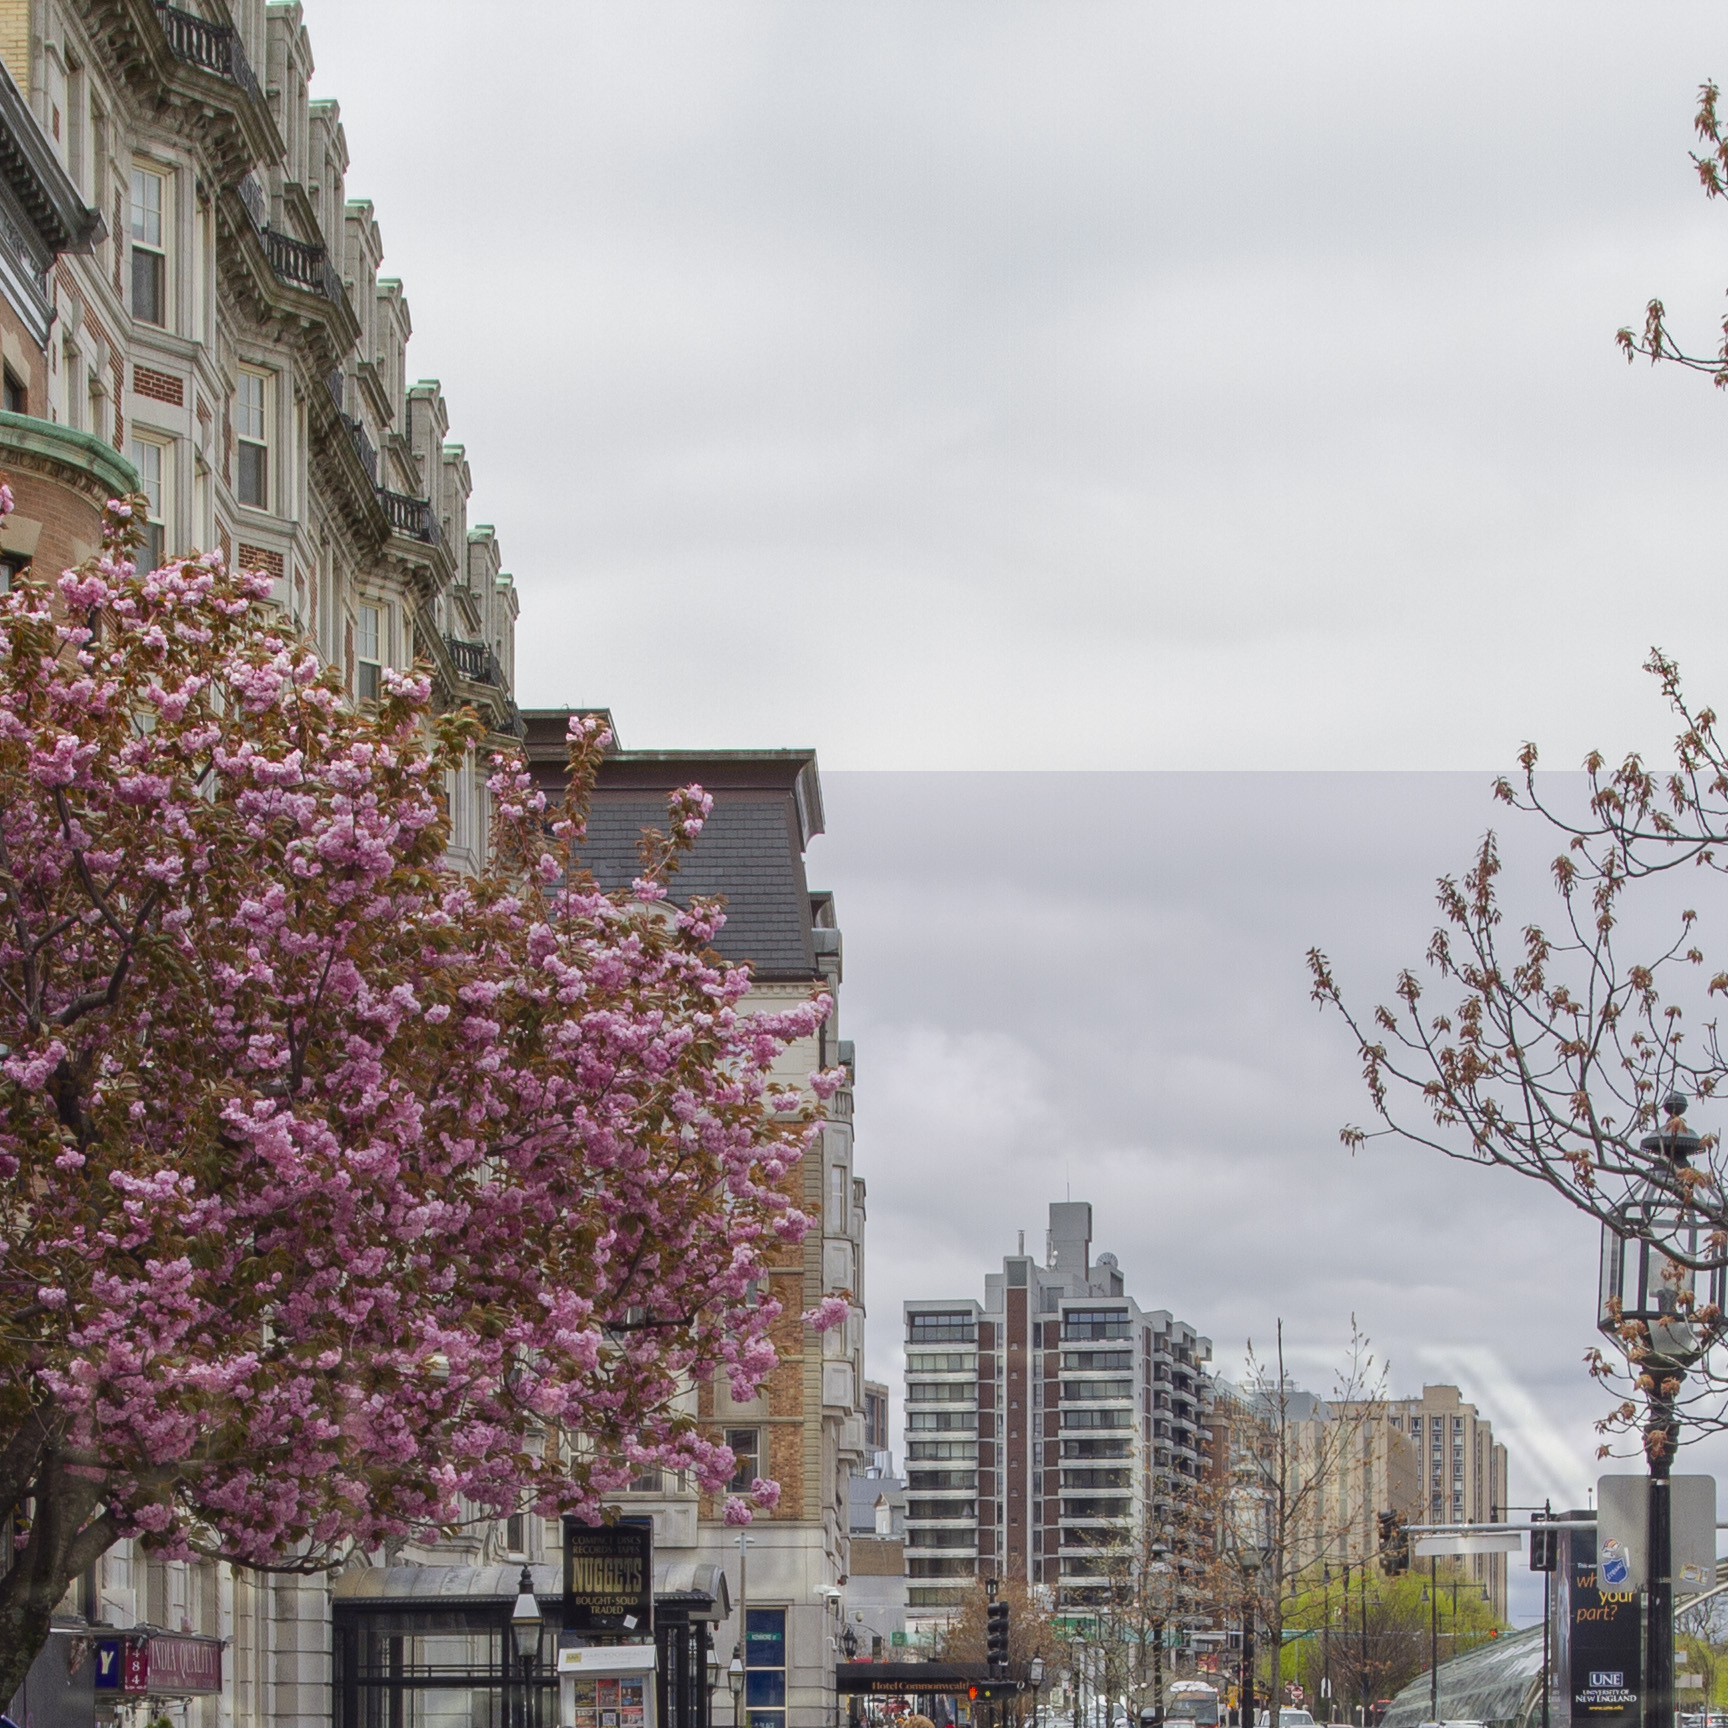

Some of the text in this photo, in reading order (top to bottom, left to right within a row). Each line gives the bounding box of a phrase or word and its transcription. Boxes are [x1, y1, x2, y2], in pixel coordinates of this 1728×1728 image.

[618, 1536, 642, 1545] DISCS
[572, 1557, 642, 1593] NUGGETS
[1599, 1591, 1633, 1606] your
[591, 1606, 624, 1614] TRADED
[1576, 1605, 1618, 1623] part?
[151, 1640, 213, 1679] INDIA QUALITY
[872, 1681, 898, 1691] Hotel
[1591, 1674, 1621, 1685] UNE
